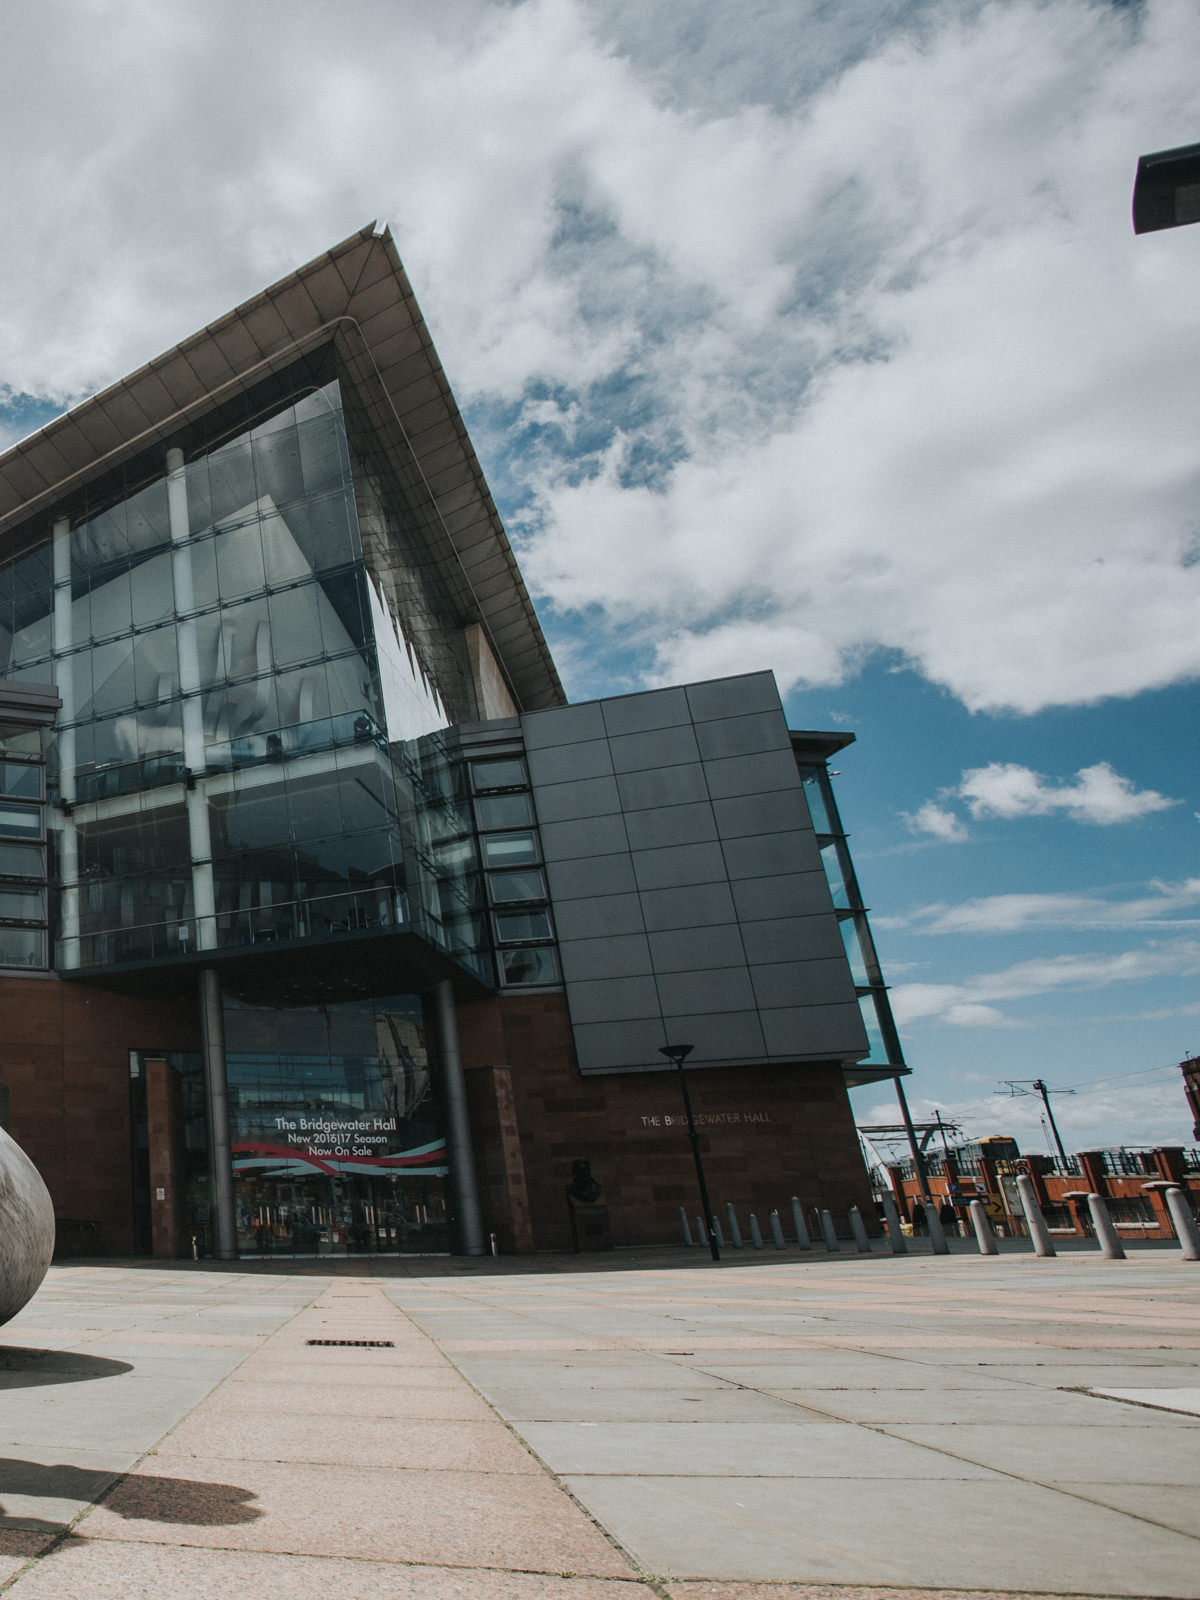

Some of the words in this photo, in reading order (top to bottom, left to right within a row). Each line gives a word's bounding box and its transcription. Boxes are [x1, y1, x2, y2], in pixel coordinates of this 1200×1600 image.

[275, 1116, 297, 1130] The
[300, 1117, 370, 1133] Bridgewater
[373, 1117, 397, 1130] Hall
[641, 1115, 661, 1127] THE
[744, 1111, 771, 1123] HALL
[288, 1133, 311, 1143] New
[354, 1133, 388, 1144] Season
[308, 1146, 331, 1156] Now
[334, 1146, 350, 1156] On
[352, 1145, 373, 1156] Sale
